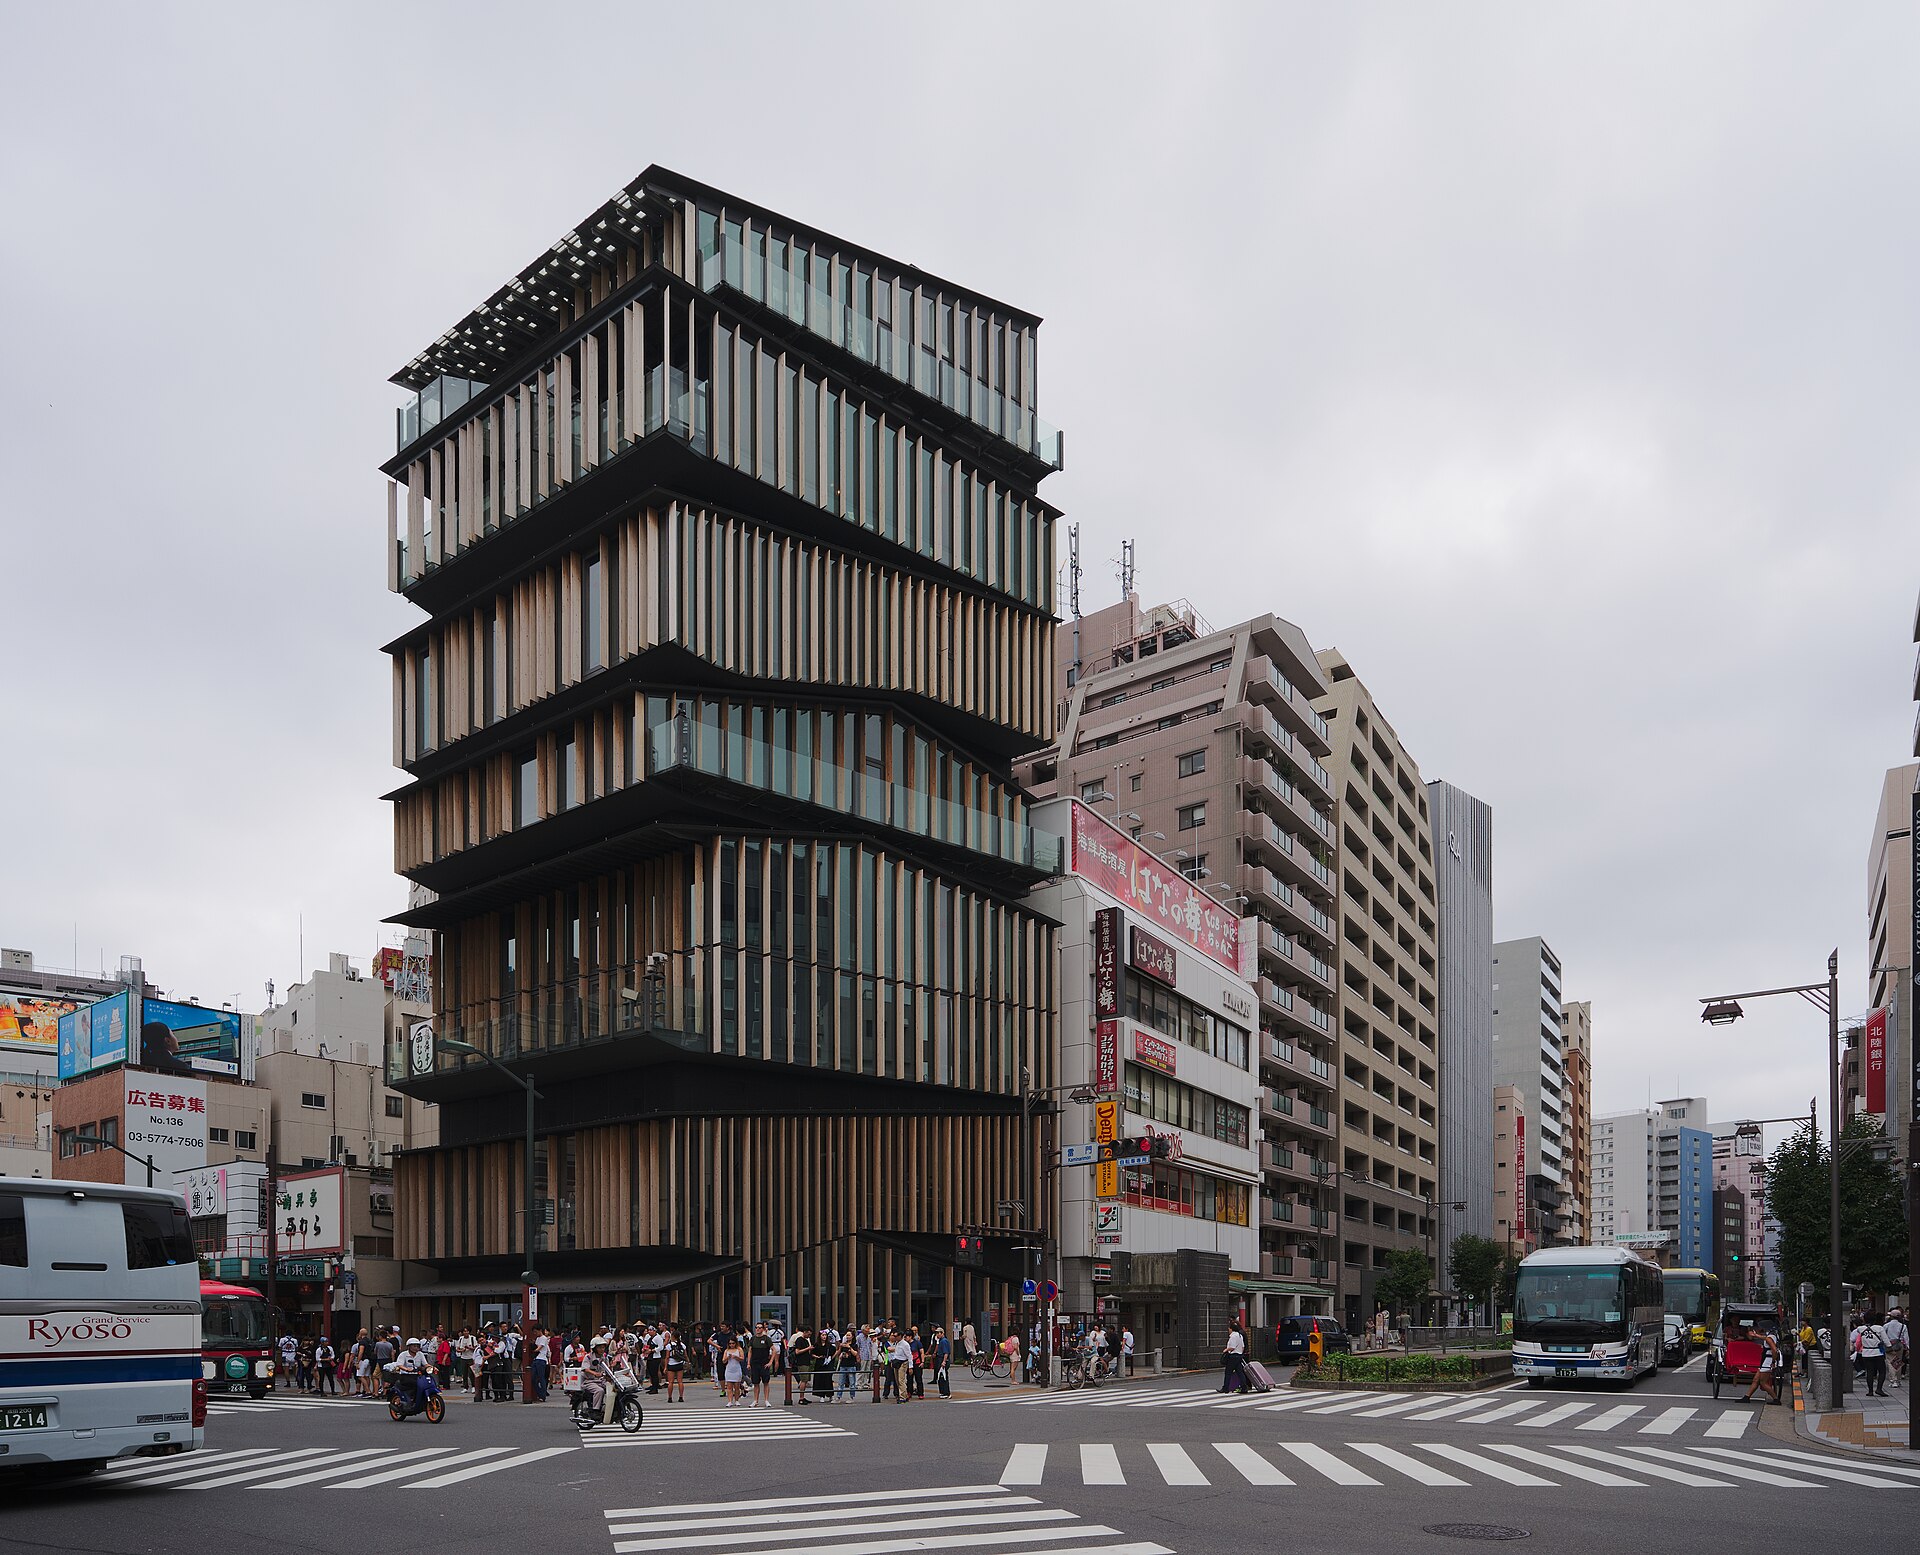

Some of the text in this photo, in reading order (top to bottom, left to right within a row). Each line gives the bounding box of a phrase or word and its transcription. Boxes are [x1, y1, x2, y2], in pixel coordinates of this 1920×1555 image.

[1077, 831, 1203, 943] 海鮮居酒屋 はなの舞
[1136, 937, 1174, 980] はなの舞
[1098, 951, 1115, 1011] はなの舞
[1870, 1026, 1883, 1071] 北陸銀行
[127, 1089, 206, 1114] 広告募集
[150, 1115, 184, 1126] No.136
[128, 1131, 204, 1148] 03-5774-7506
[1067, 1145, 1093, 1157] 雷門
[285, 1214, 321, 1237] 西むら
[82, 1316, 150, 1324] Grand Service
[28, 1319, 132, 1348] Ryoso
